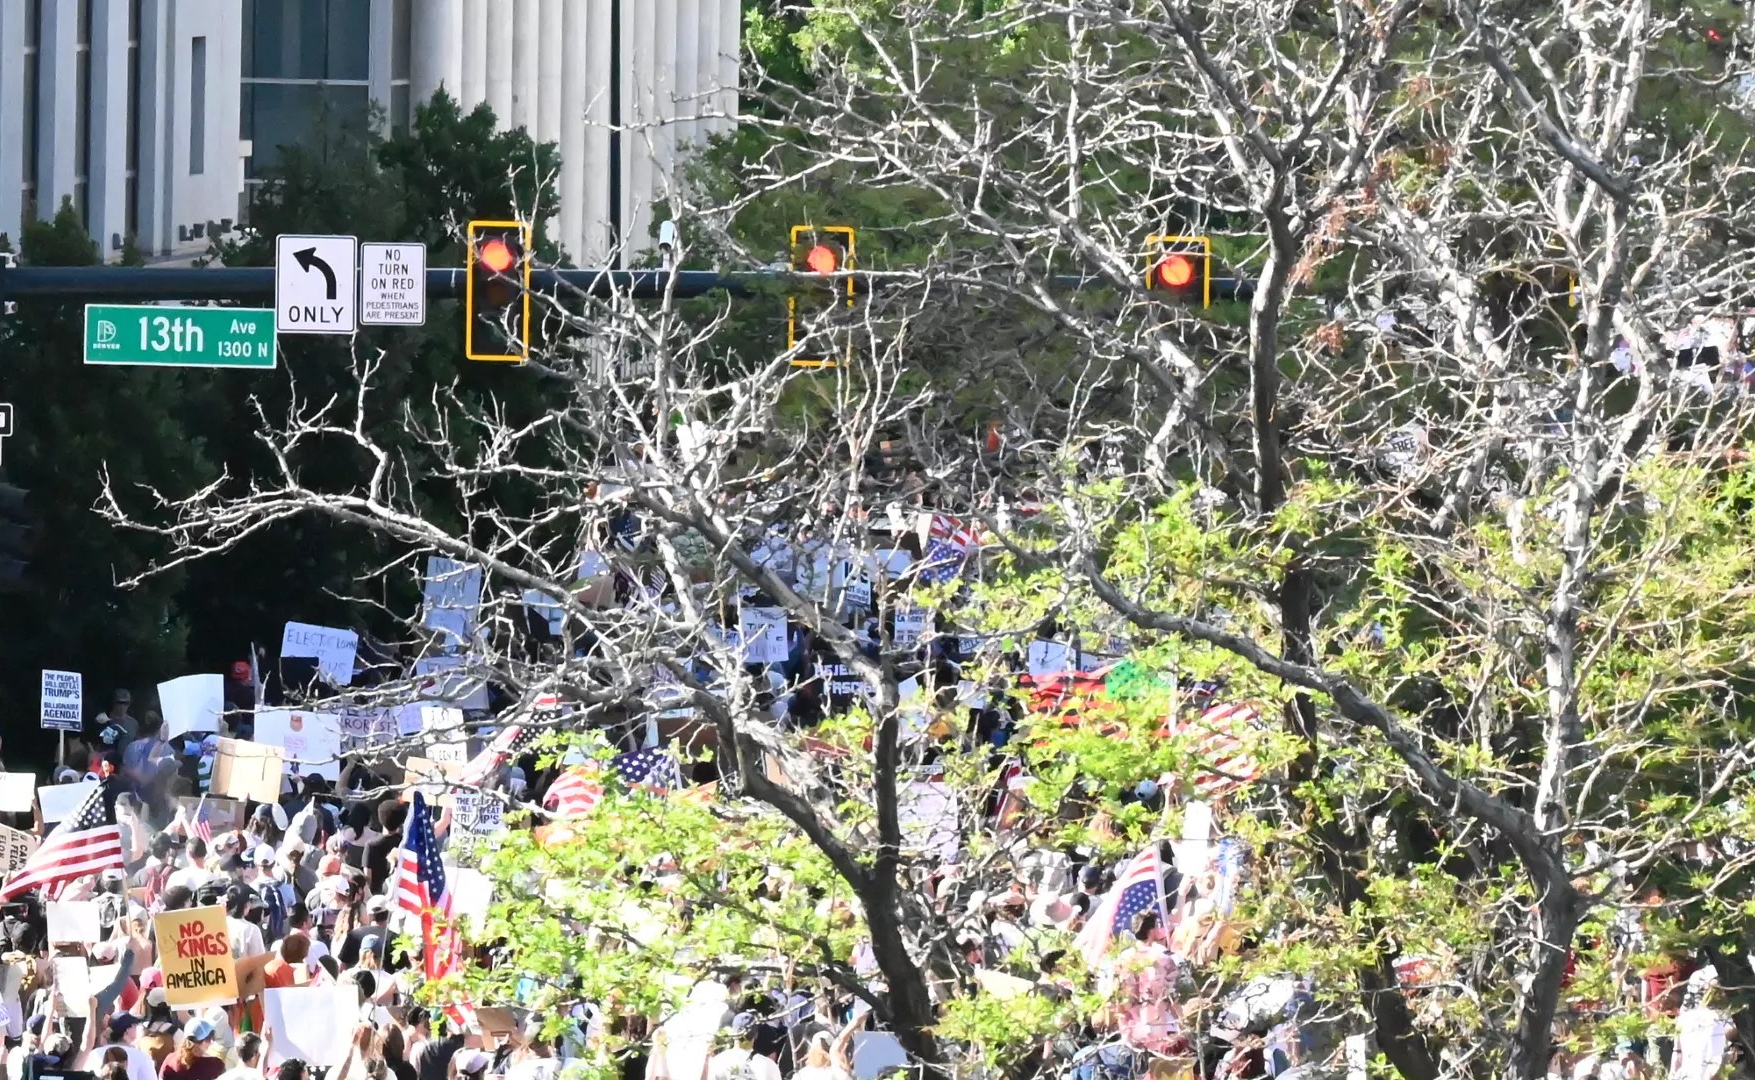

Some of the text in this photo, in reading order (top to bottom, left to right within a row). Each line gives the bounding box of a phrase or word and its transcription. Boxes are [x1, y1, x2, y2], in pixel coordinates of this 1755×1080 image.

[385, 249, 401, 261] NO
[378, 264, 409, 276] TURN
[371, 278, 415, 290] ON RED
[380, 292, 405, 301] WHEN
[366, 302, 419, 310] PEDESTRIANS
[288, 305, 344, 323] ONLY
[366, 311, 419, 320] ARE PRESENT
[139, 316, 256, 352] 13th Ave
[218, 341, 268, 358] 1300 N
[44, 688, 80, 700] TRUMP'S
[43, 710, 80, 719] AGENDA!
[179, 920, 205, 939] NO
[176, 932, 229, 959] KINGS
[190, 958, 205, 974] IN
[166, 967, 227, 990] AMERICA
